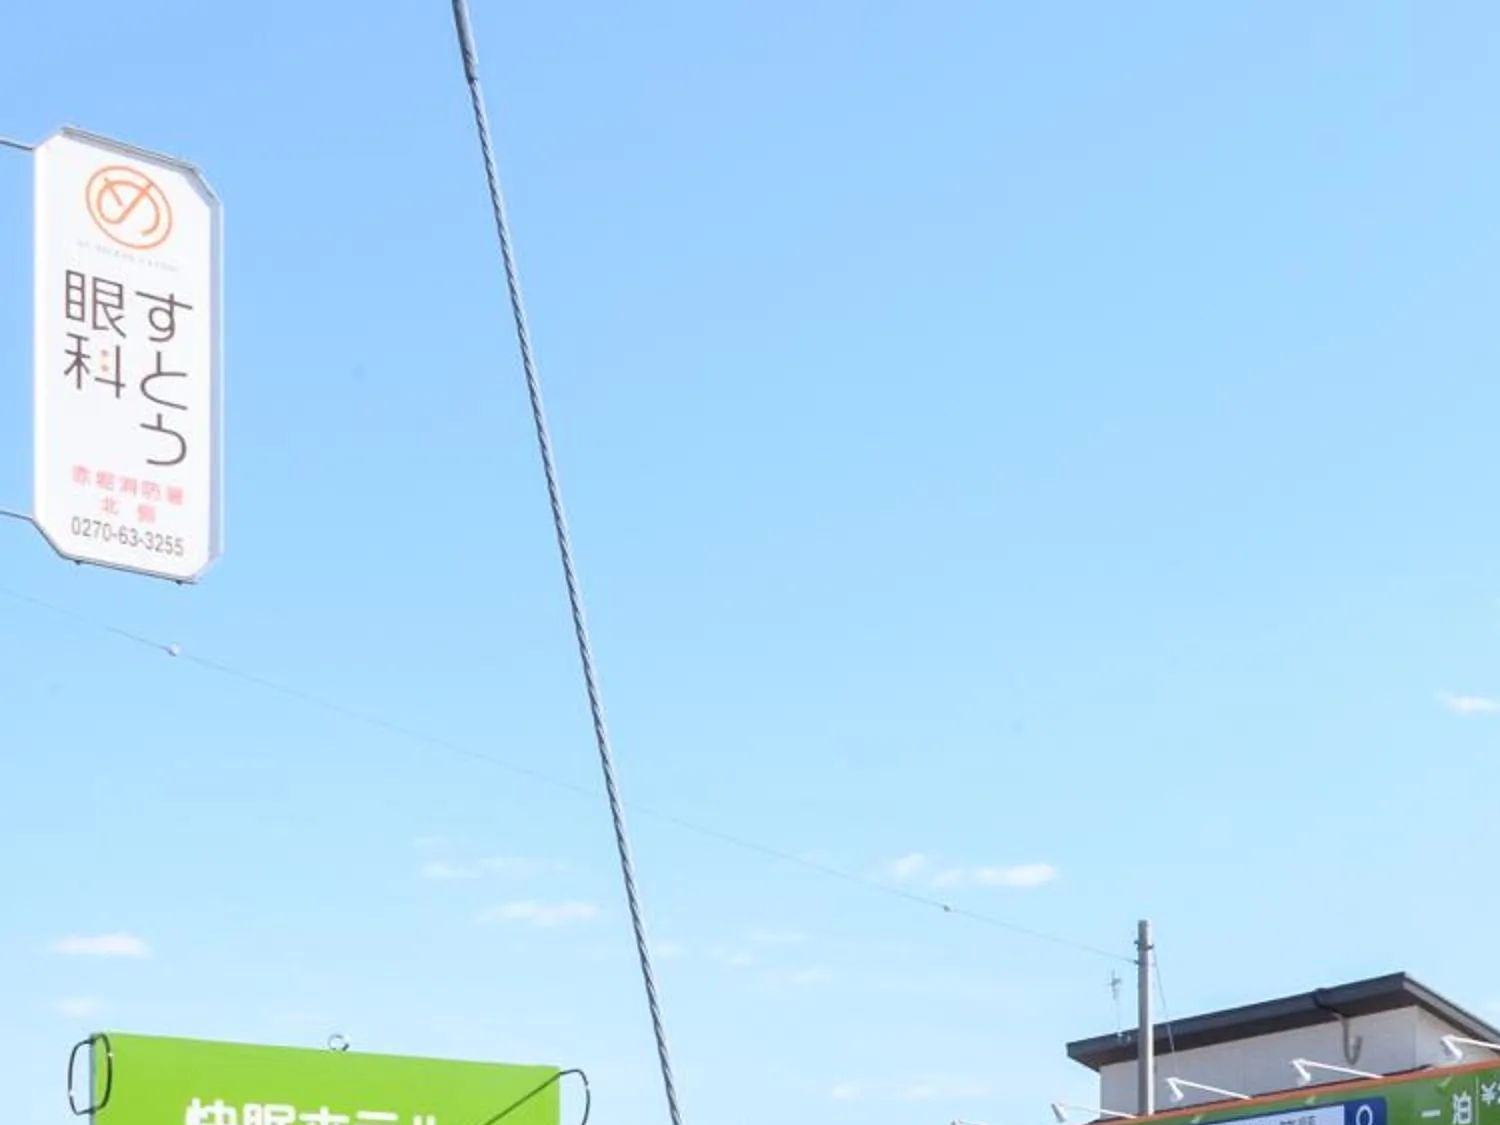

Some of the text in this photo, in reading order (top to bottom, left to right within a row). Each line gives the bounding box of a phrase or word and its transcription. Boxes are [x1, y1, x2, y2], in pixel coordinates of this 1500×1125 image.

[64, 269, 127, 399] 眼科
[136, 292, 193, 466] すとう
[71, 516, 186, 557] 0270-63-3255
